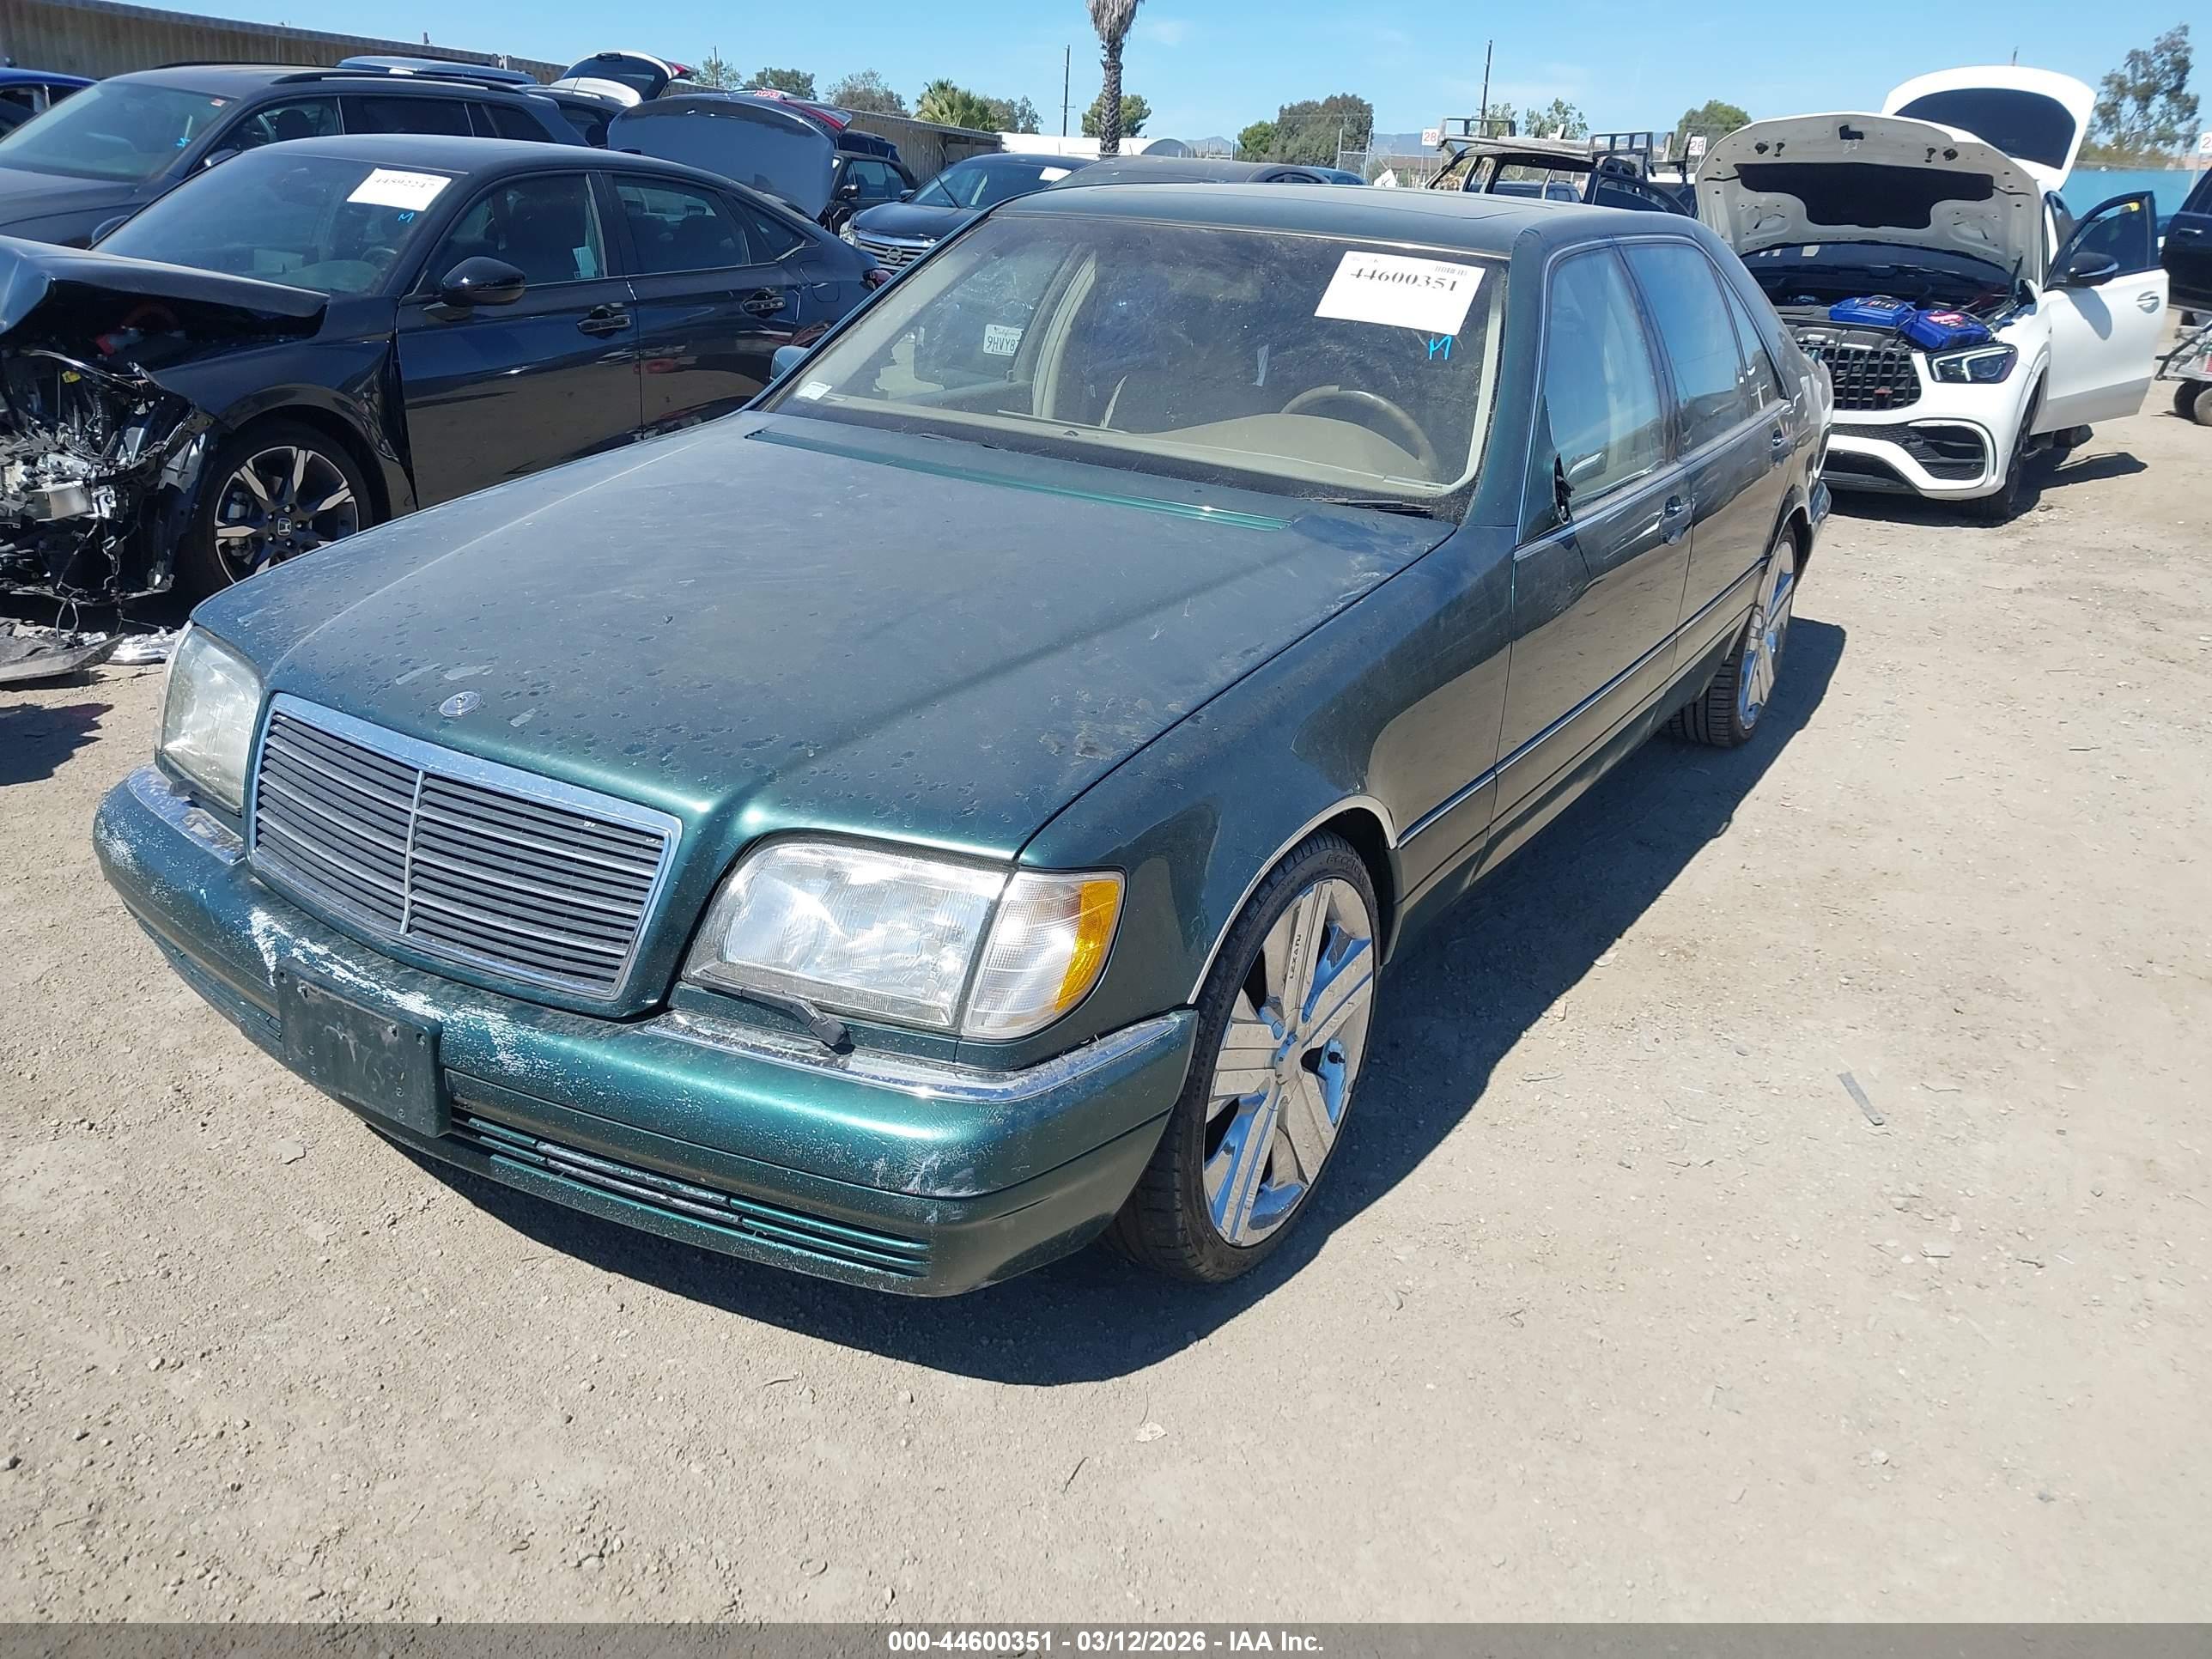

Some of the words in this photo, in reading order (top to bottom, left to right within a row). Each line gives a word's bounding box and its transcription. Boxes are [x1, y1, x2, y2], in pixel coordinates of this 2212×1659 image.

[1424, 131, 1437, 143] 28
[2202, 137, 2212, 149] 2
[1350, 267, 1458, 292] 44600351
